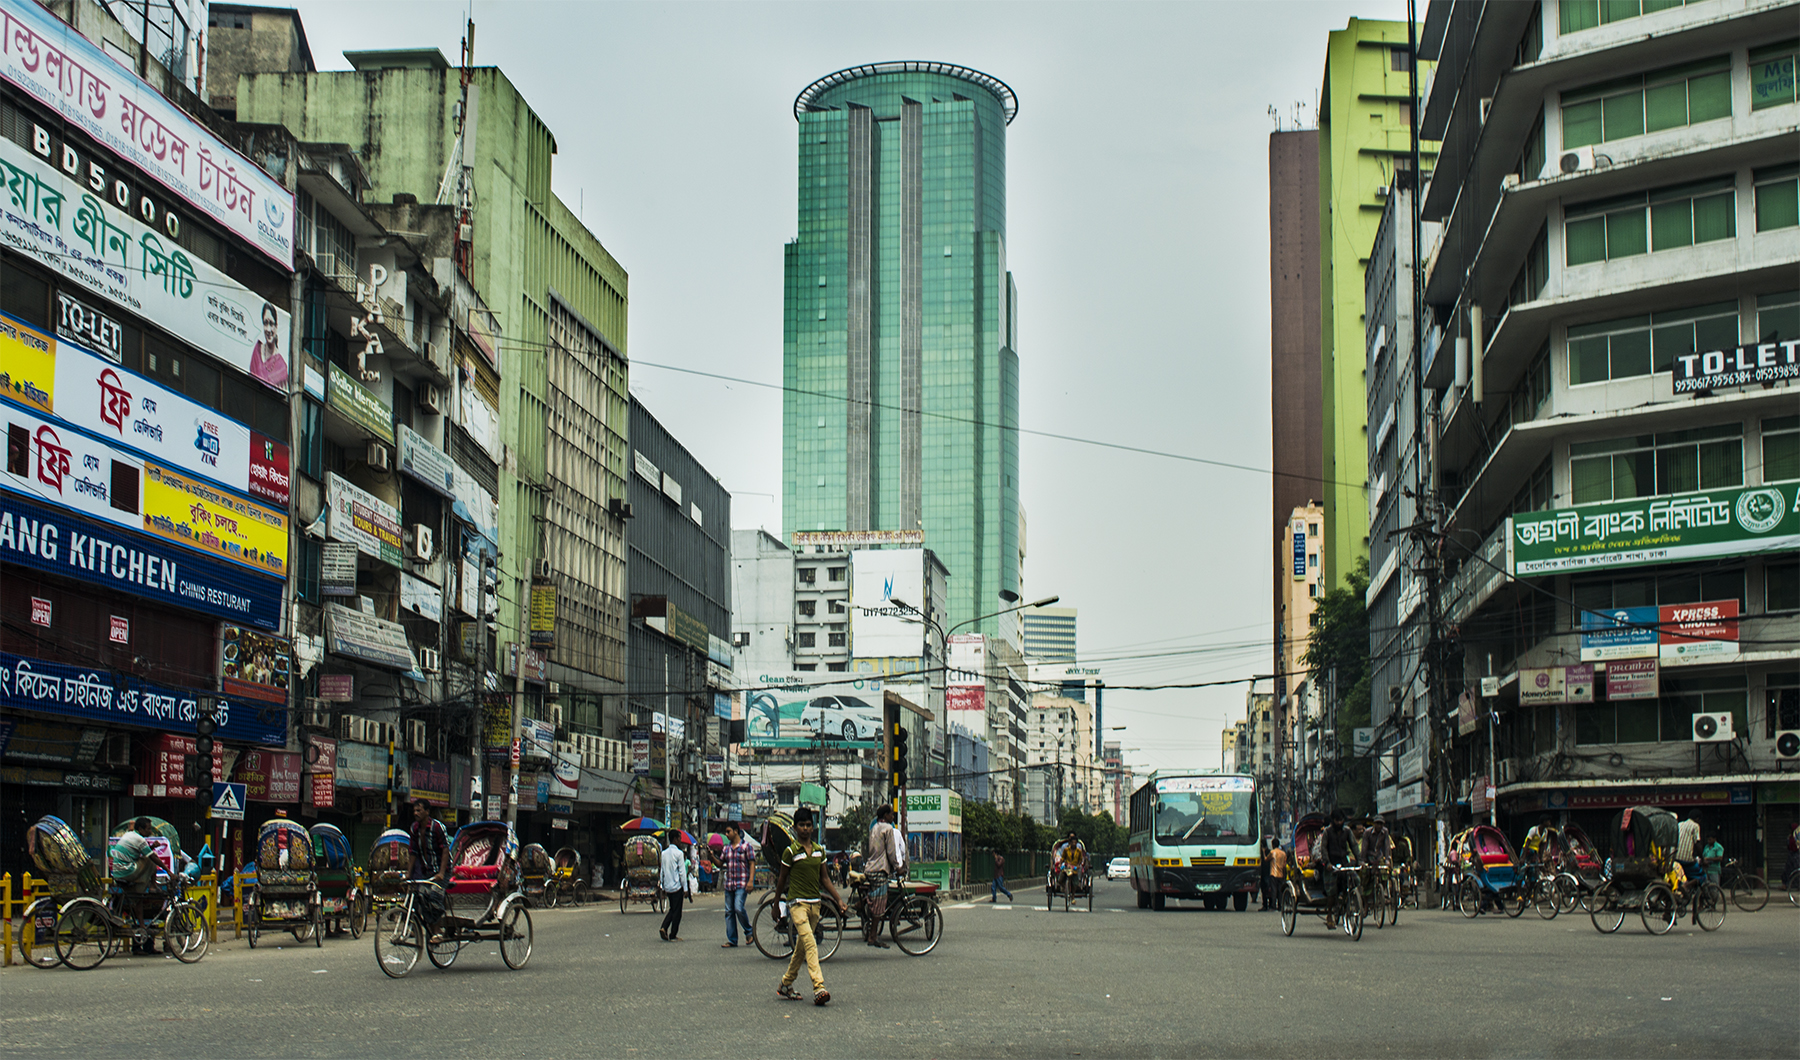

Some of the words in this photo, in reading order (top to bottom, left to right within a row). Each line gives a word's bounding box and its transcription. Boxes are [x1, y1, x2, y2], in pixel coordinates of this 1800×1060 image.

[120, 94, 189, 176] মডেল
[197, 140, 255, 222] টাউন
[73, 193, 133, 270] গ্রীন
[138, 232, 198, 299] সিটি
[258, 220, 289, 249] GOLDLAND
[59, 295, 120, 350] TO-LET
[1678, 339, 1800, 378] TO-LET
[96, 368, 133, 436] ফ্রি
[142, 397, 157, 414] হোম
[203, 421, 219, 436] FREE
[32, 425, 73, 497] ফ্রি
[84, 454, 99, 471] হোম
[189, 502, 212, 528] বুকিং
[353, 501, 373, 520] STUDENT
[1516, 511, 1579, 546] অগ্রণী
[1584, 510, 1645, 541] ব্যাংক
[1649, 496, 1730, 532] লিমিটেড
[354, 515, 373, 533] TOURS
[378, 528, 402, 547] TRAVELS
[70, 531, 177, 593] KITCHEN
[179, 580, 206, 601] CHINIS
[207, 588, 251, 613] RESTURANT
[32, 608, 50, 624] OPEN
[1672, 606, 1719, 620] XPRESS
[110, 627, 127, 641] OPEN
[15, 660, 61, 701] কিচেন
[64, 673, 113, 711] চাইনিজ
[142, 690, 176, 720] বাংলা
[760, 675, 784, 683] Clean
[899, 796, 940, 805] SSURE
